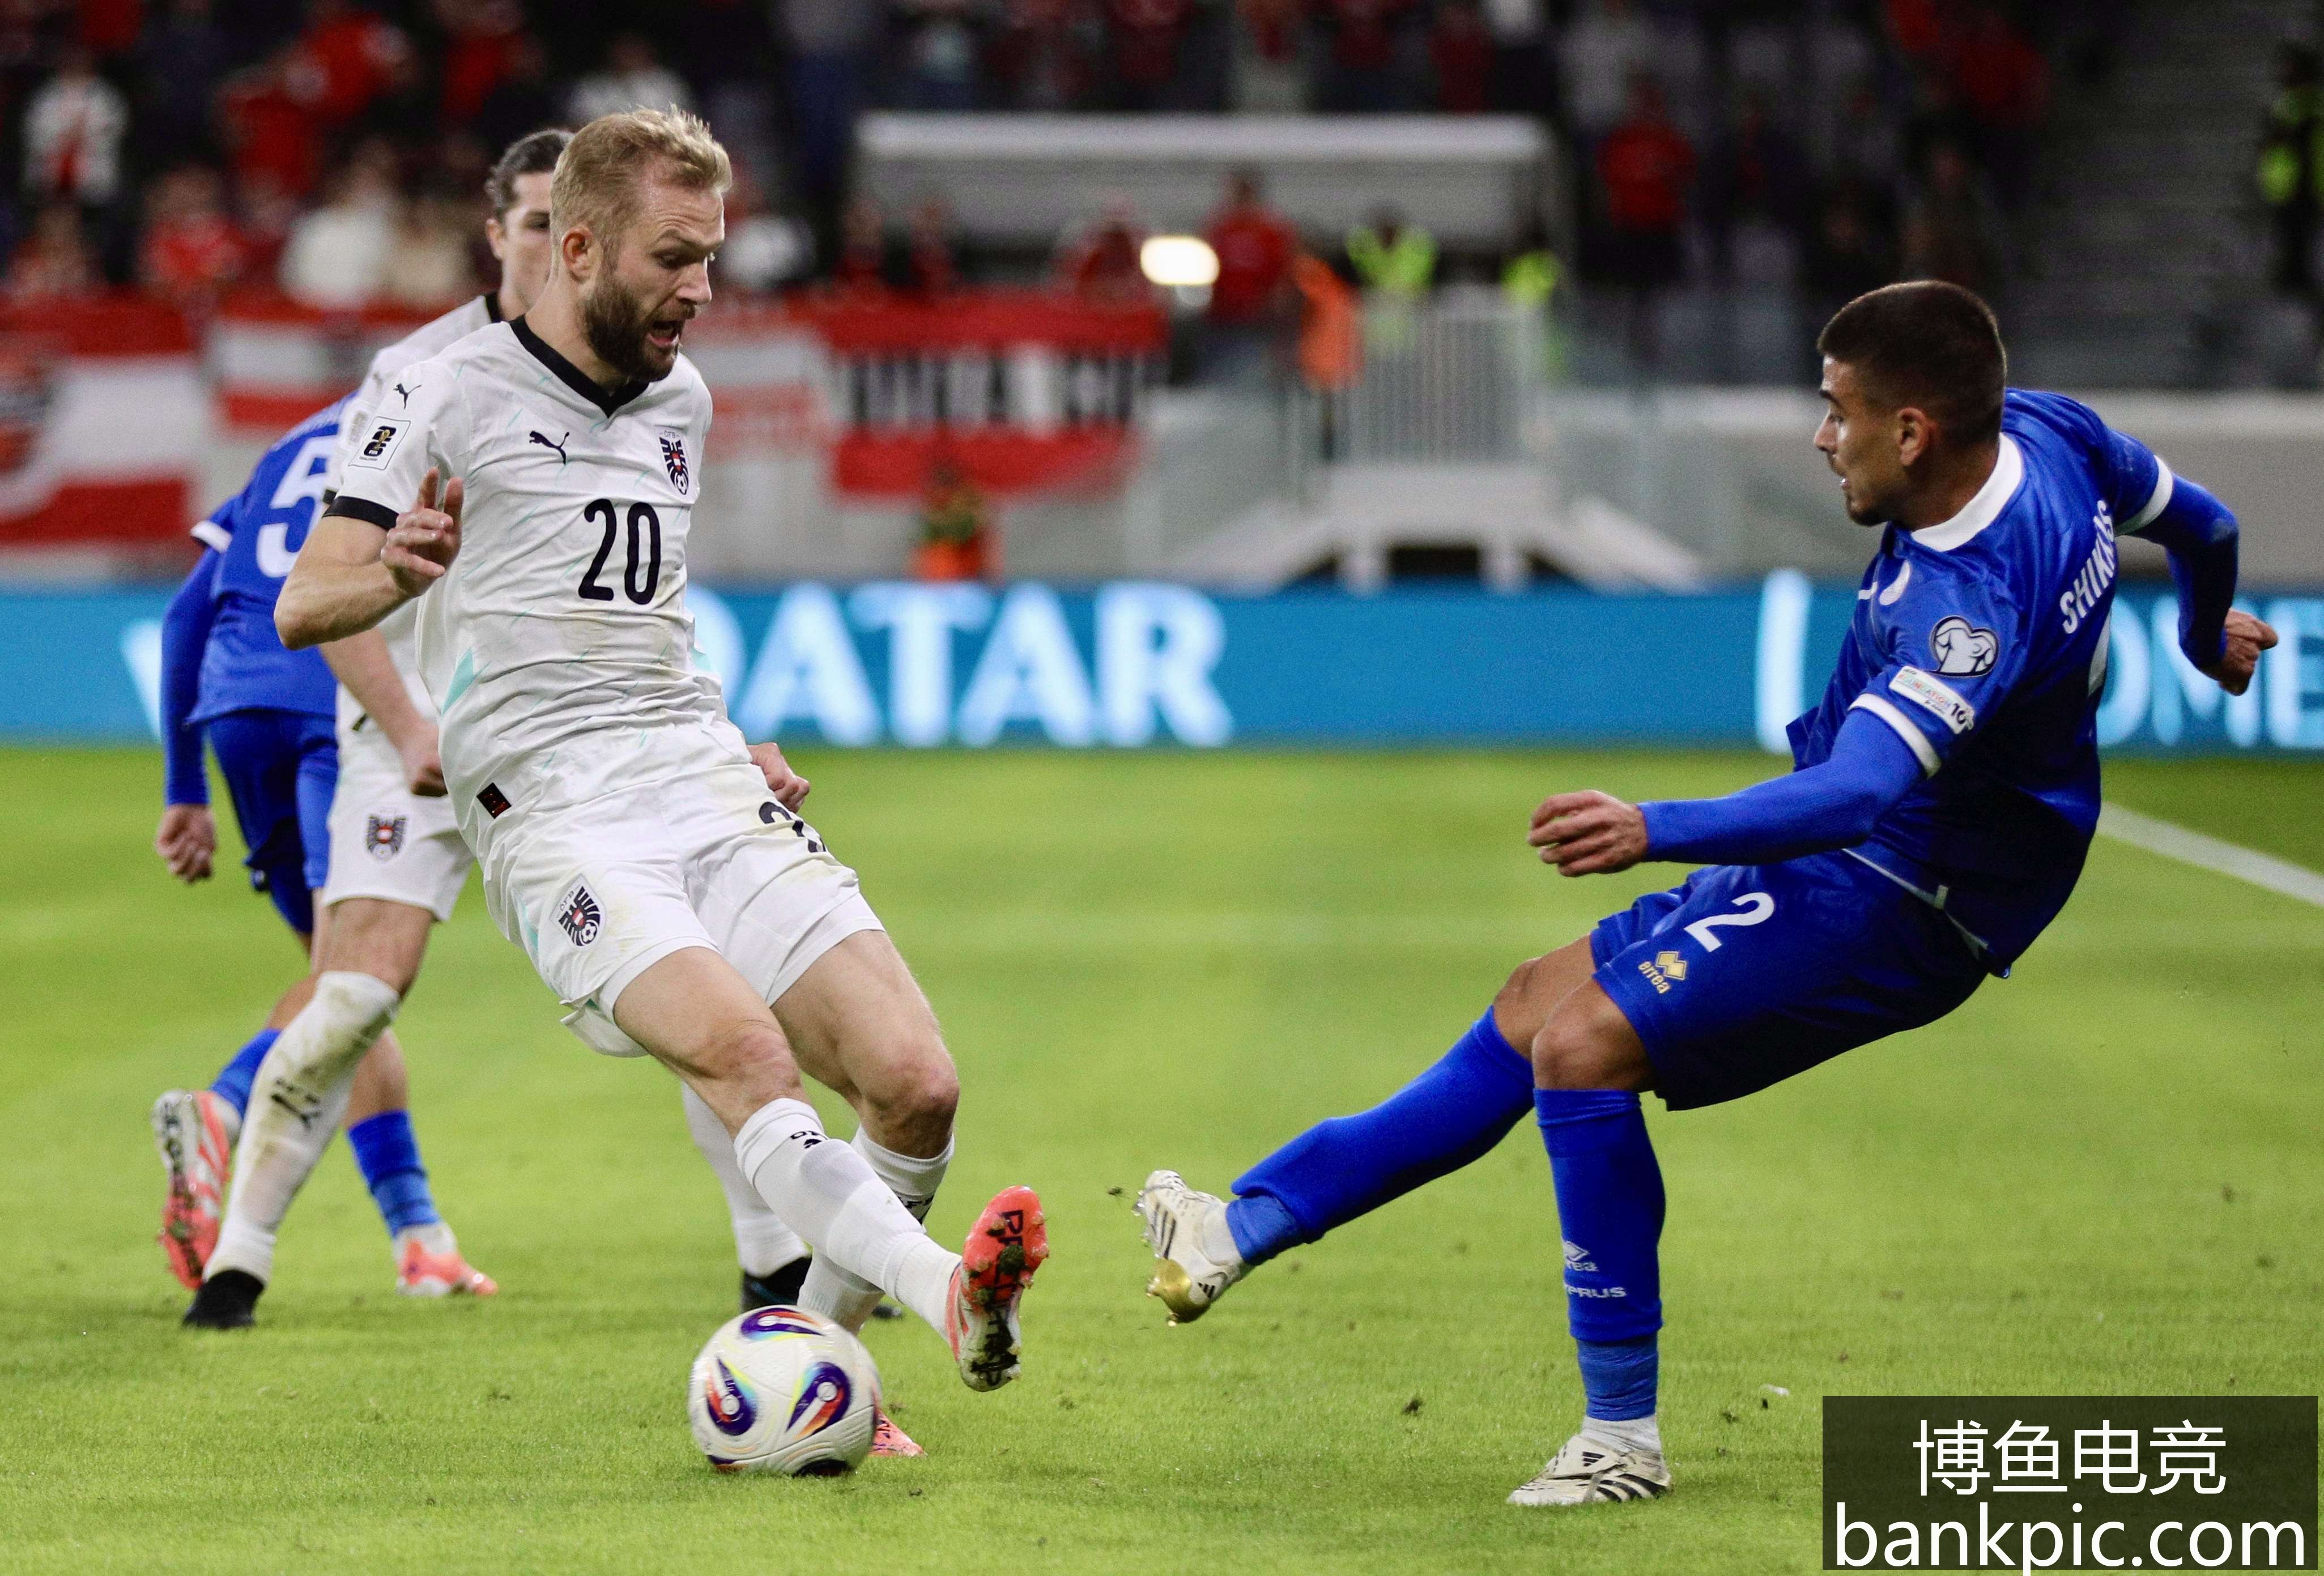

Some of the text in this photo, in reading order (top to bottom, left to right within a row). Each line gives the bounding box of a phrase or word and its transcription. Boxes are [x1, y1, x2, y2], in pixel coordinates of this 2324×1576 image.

[256, 435, 337, 578] 5
[578, 498, 661, 605] 20
[1683, 892, 1775, 952] 2
